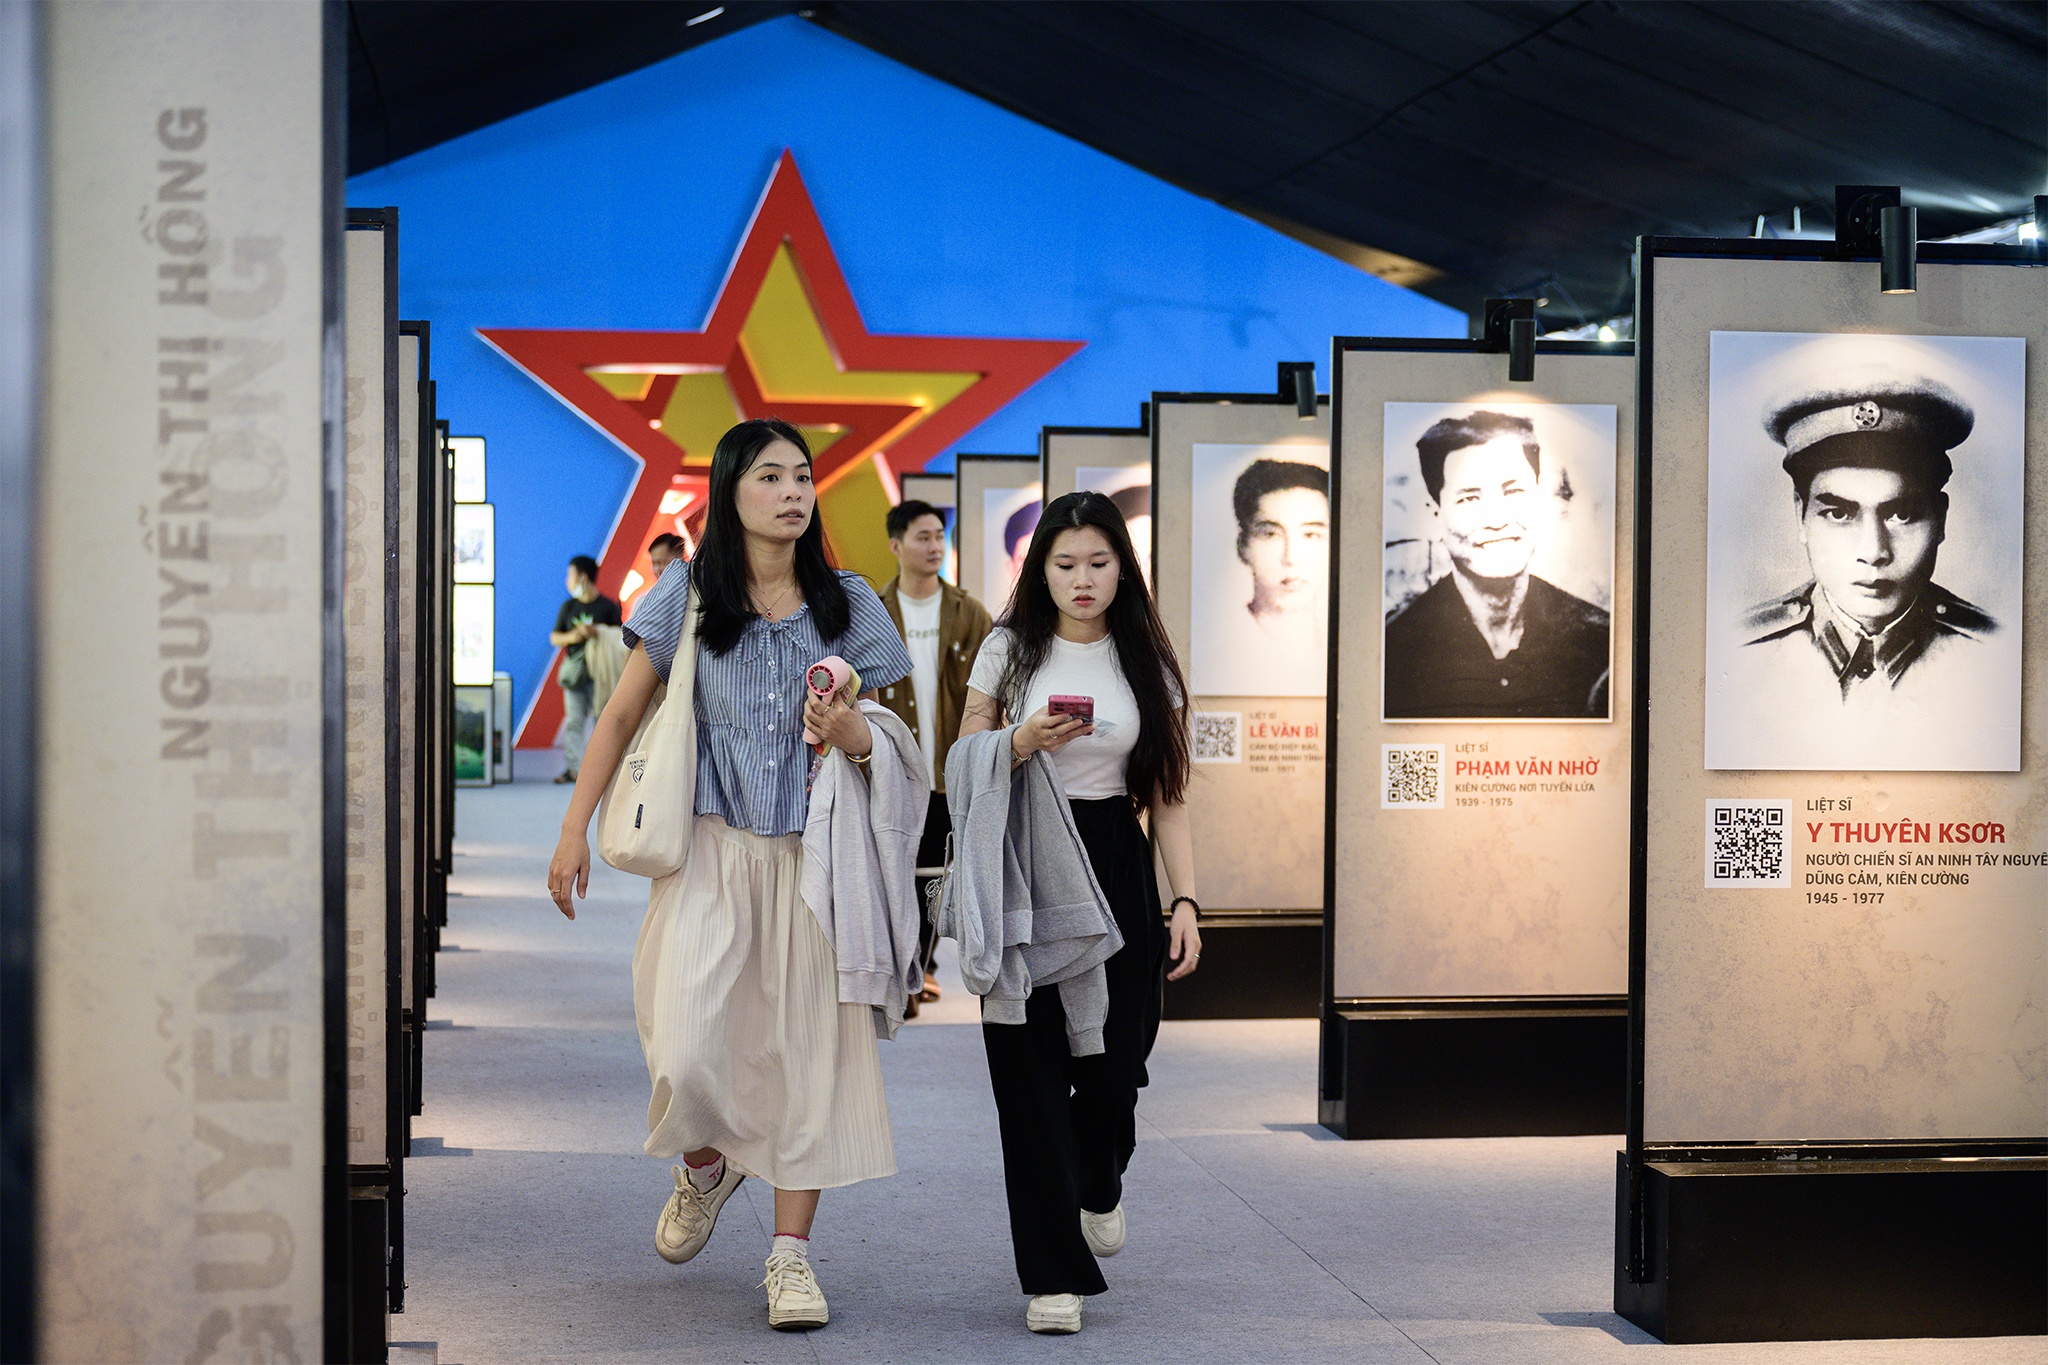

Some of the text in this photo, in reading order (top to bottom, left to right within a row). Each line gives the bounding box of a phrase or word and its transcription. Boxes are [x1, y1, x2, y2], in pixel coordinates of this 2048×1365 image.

[136, 107, 222, 761] NGUYỄN THỊ HỒNG
[1250, 722, 1267, 738] LÊ
[1271, 721, 1301, 738] VĂN
[1455, 741, 1489, 754] LIỆT SĨ
[1456, 756, 1600, 779] PHẠM VĂN NHỜ
[191, 676, 312, 881] THỊ
[1455, 781, 1595, 793] KIÊN CƯỜNG NƠI TUYẾN LỬA
[1456, 797, 1479, 807] 1939
[1490, 797, 1514, 807] 1975
[1806, 796, 1853, 813] LIỆT SĨ
[1806, 817, 2006, 843] Y THUYÊN KSƠR
[1805, 850, 2048, 866] NGƯỜI CHIẾN SĨ AN NINH TÂY NGUYÊ
[1805, 869, 1970, 887] DŨNG CẢM, KIÊN CƯỜNG
[1806, 892, 1838, 904] 1945
[1852, 892, 1885, 904] 1977
